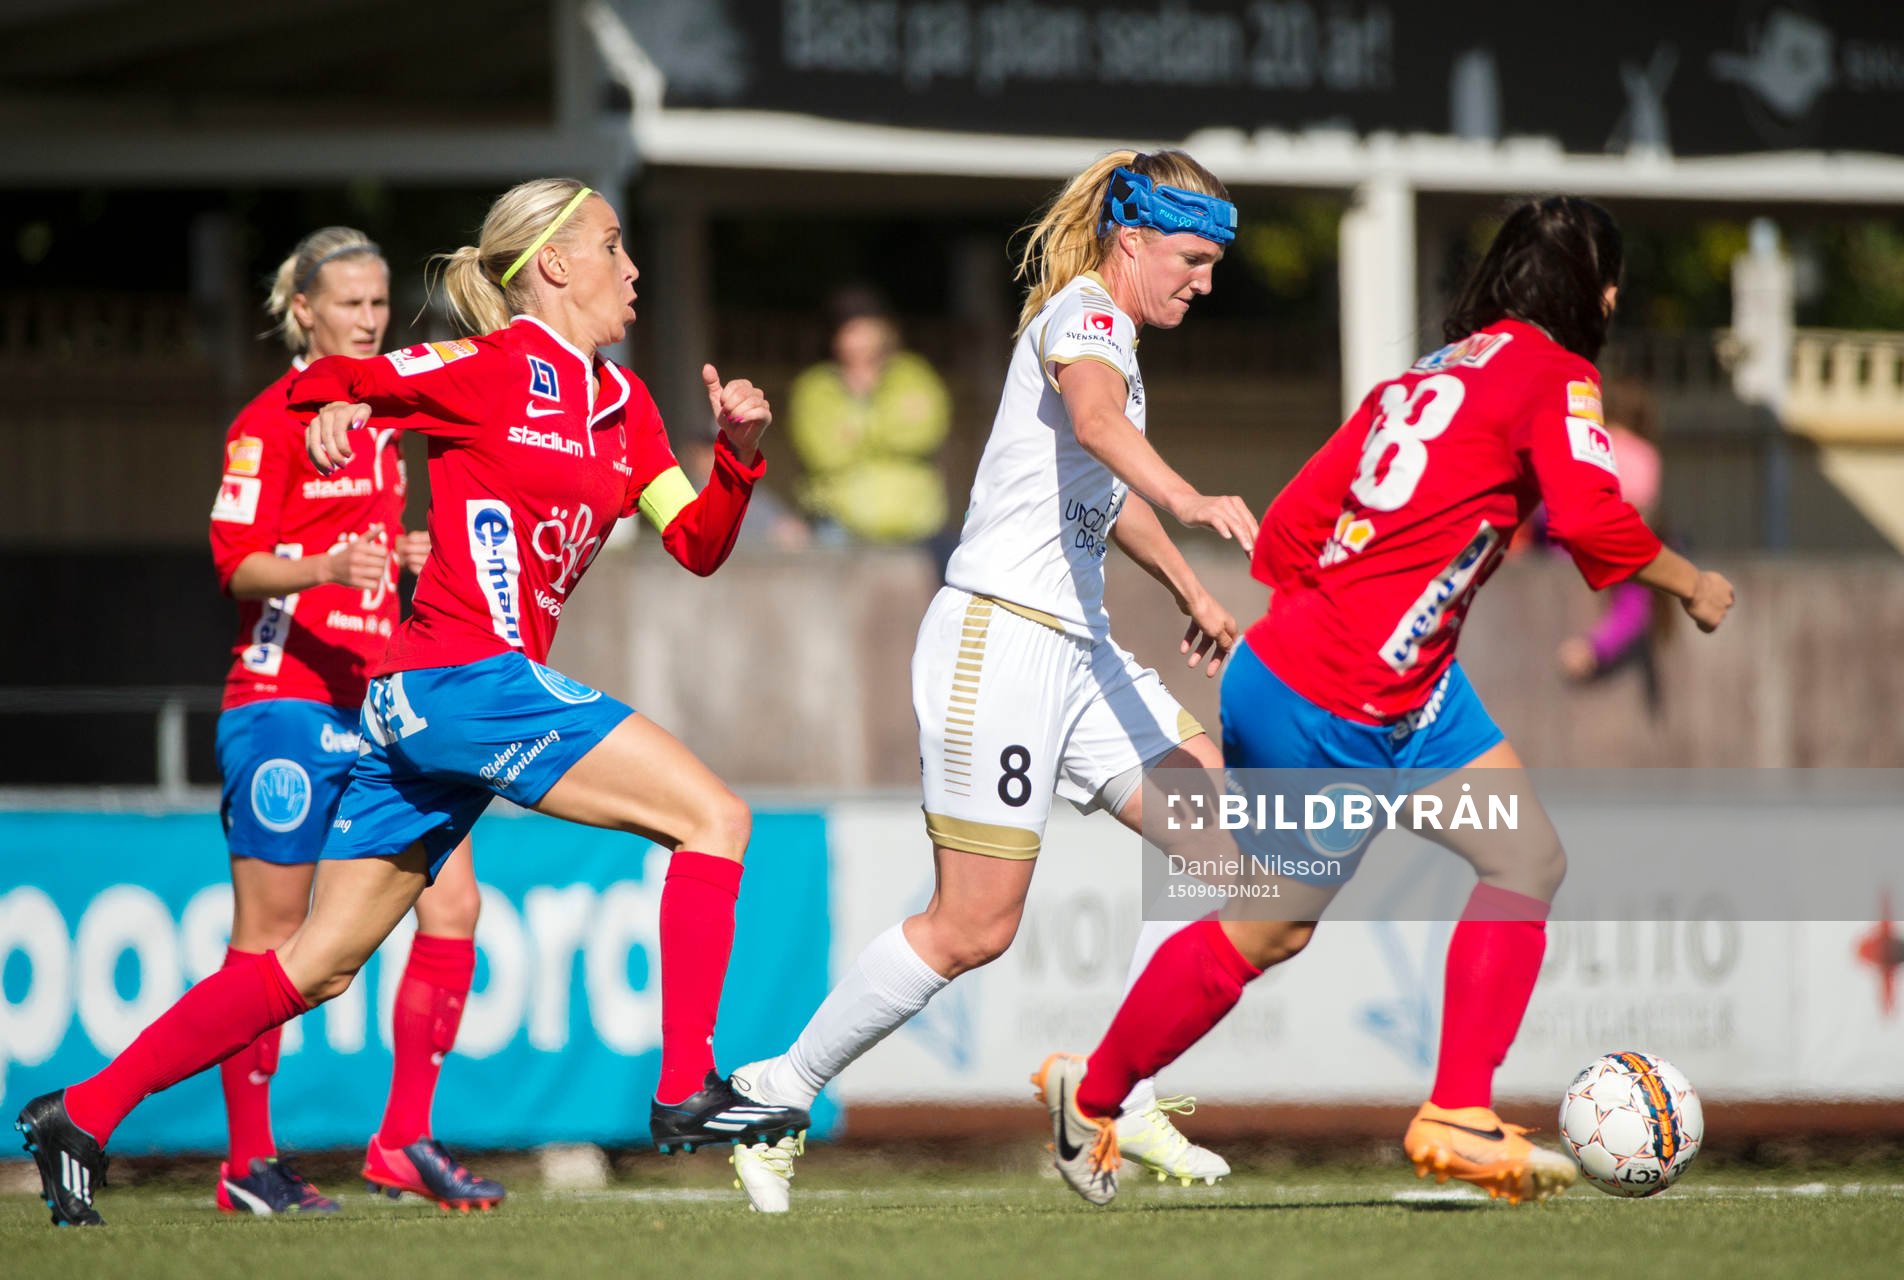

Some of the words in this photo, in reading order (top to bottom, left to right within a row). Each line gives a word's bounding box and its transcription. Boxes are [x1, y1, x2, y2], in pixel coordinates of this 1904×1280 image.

[1066, 331, 1105, 342] SVENSKA
[507, 425, 584, 459] stadium
[302, 477, 372, 499] stadium
[997, 744, 1032, 808] 8
